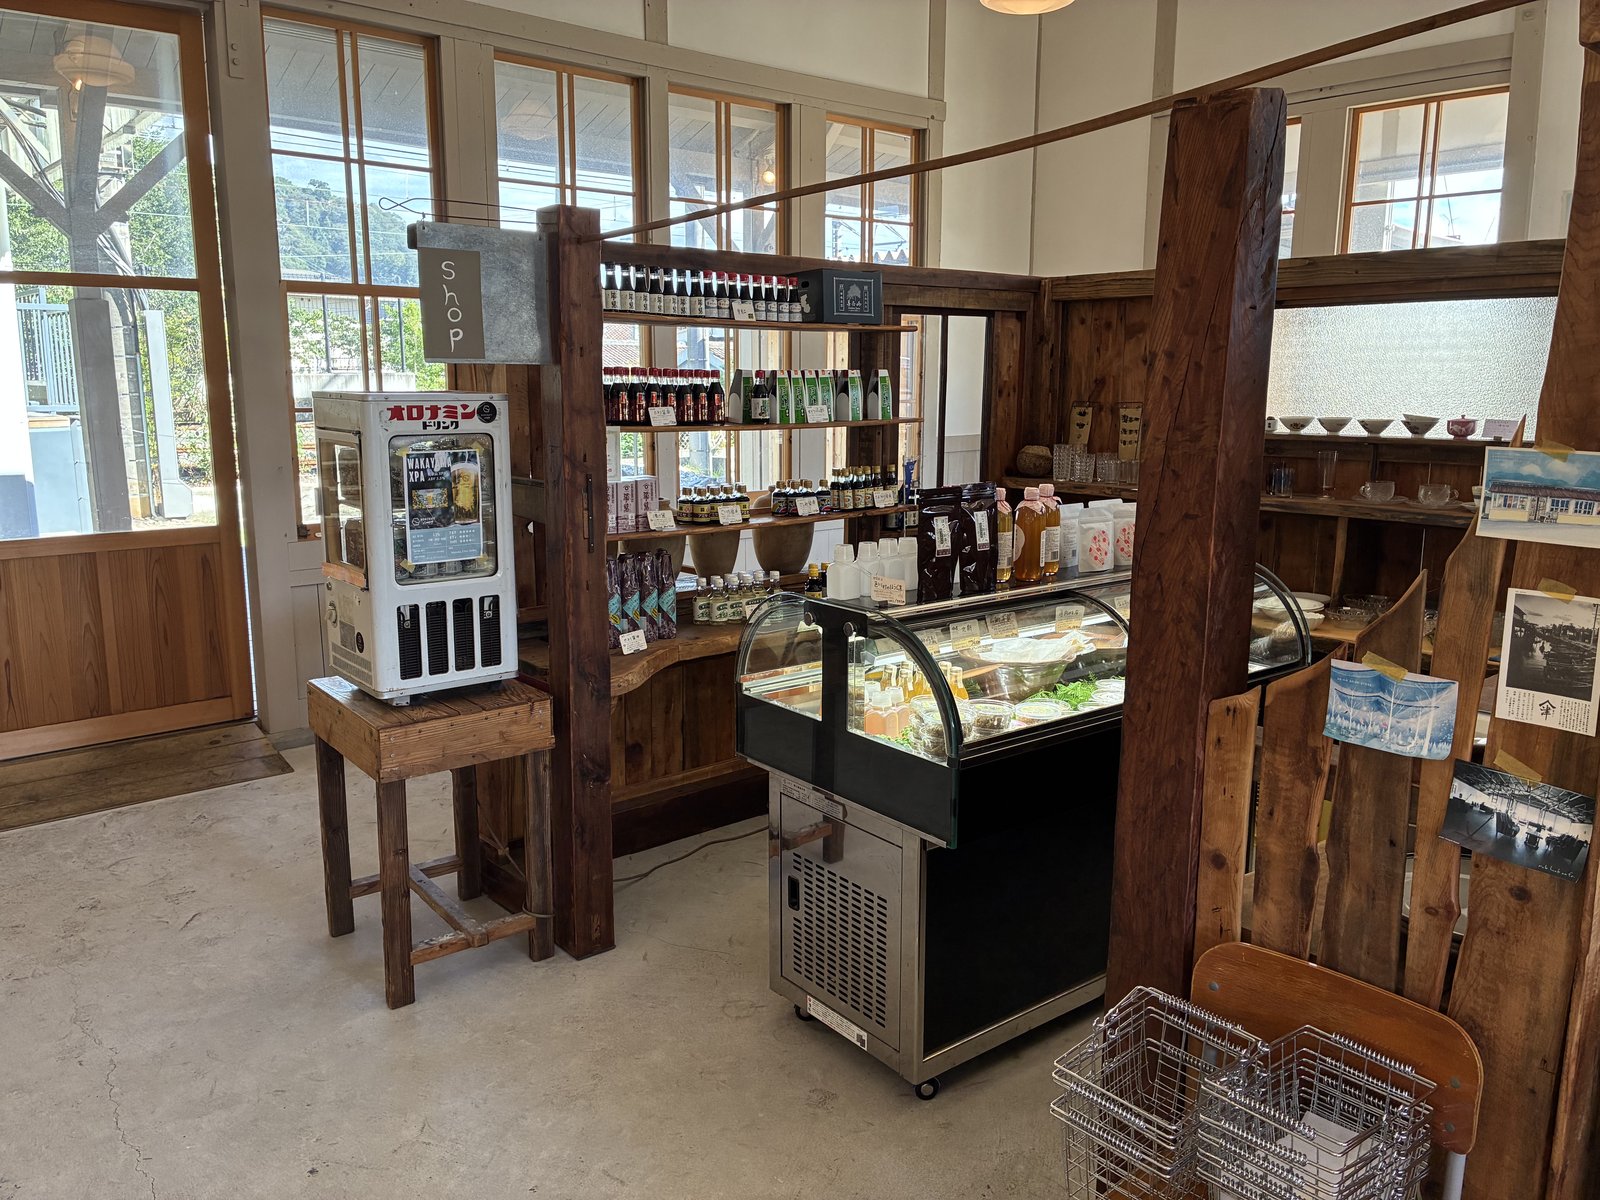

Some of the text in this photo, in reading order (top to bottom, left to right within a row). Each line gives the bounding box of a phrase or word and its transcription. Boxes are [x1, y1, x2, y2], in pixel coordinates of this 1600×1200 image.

[386, 403, 476, 421] オロナミン
[422, 421, 459, 430] ドリンク
[408, 471, 426, 483] XPA
